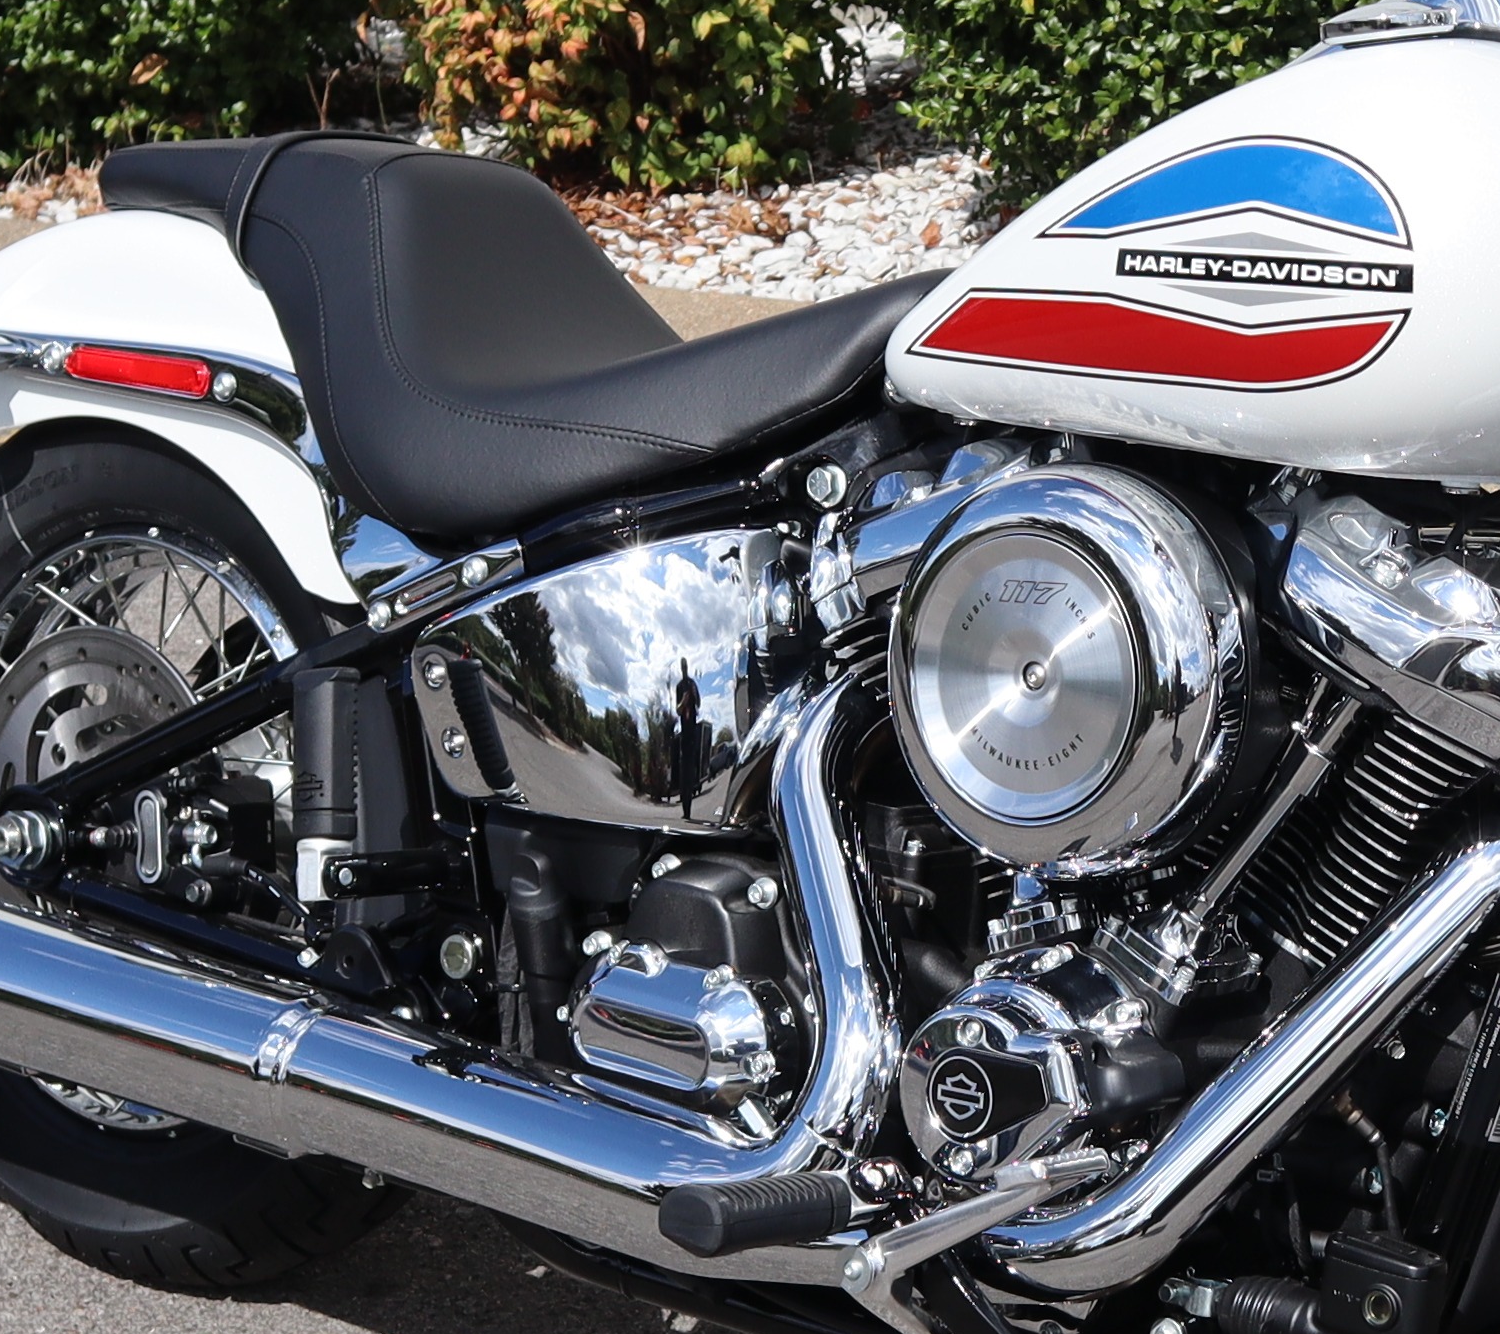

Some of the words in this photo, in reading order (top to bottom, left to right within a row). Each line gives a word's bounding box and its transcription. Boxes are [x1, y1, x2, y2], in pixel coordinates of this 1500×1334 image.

[1124, 254, 1399, 287] HARLEY-DAVIDSON
[961, 592, 992, 631] CUBIC
[999, 579, 1068, 605] 117
[1064, 596, 1097, 641] INCHS
[971, 725, 1085, 771] MILWAUKEE-EIGHT
